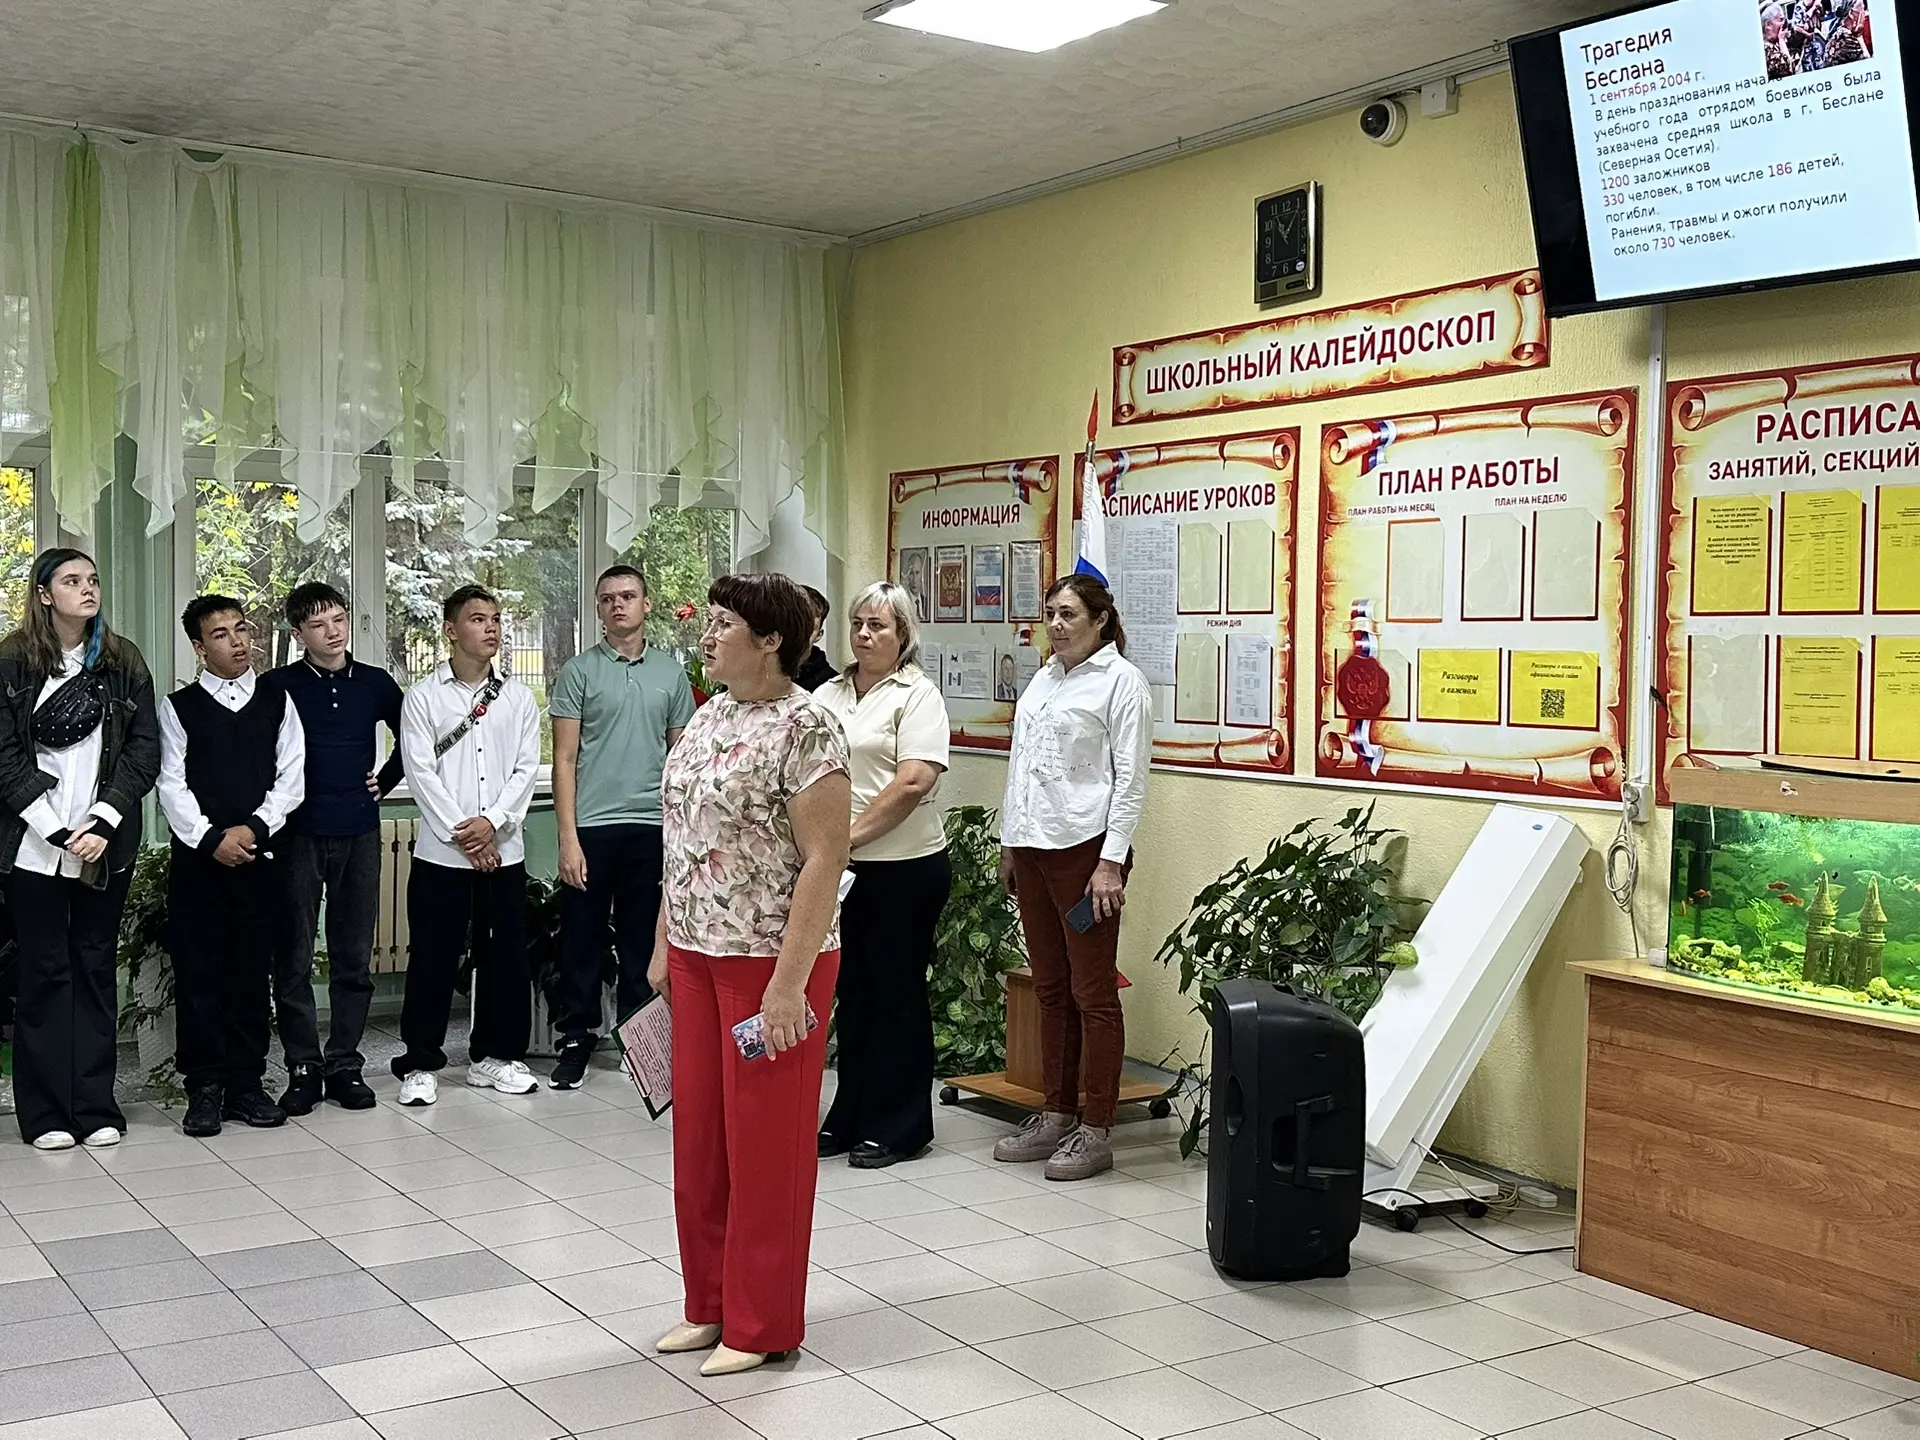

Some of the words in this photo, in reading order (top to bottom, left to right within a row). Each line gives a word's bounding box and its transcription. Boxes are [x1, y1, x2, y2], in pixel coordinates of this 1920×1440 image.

[1580, 28, 1672, 65] Трагедия
[1585, 58, 1665, 90] Беслана
[1589, 93, 1597, 105] 1
[1600, 82, 1657, 103] сентября
[1659, 71, 1691, 89] 2004
[1694, 71, 1706, 82] г.
[1594, 119, 1650, 143] учебного
[1659, 111, 1688, 126] года
[1698, 97, 1756, 117] отрядом
[1766, 80, 1832, 103] боевиков
[1843, 70, 1881, 87] была
[1595, 109, 1603, 122] В
[1607, 105, 1636, 121] день
[1640, 83, 1731, 112] празднования
[1596, 135, 1658, 156] захвачена
[1667, 122, 1720, 143] средняя
[1730, 112, 1773, 130] школа
[1783, 108, 1792, 119] в
[1801, 104, 1812, 116] г.
[1822, 89, 1884, 111] Беслане
[1598, 152, 1661, 175] (Северная
[1664, 139, 1720, 160] Осетия).
[1601, 174, 1630, 191] 1200
[1633, 161, 1711, 185] заложников
[1603, 192, 1625, 207] 330
[1628, 184, 1682, 202] человек,
[1686, 182, 1694, 193] в
[1696, 177, 1721, 191] том
[1724, 169, 1764, 185] числе
[1768, 161, 1792, 178] 186
[1797, 153, 1844, 175] детей,
[1282, 199, 1292, 213] 12
[1605, 206, 1660, 224] погибли.
[1611, 222, 1666, 239] Ранения,
[1669, 213, 1718, 231] травмы
[1721, 211, 1730, 222] и
[1733, 203, 1776, 219] ожоги
[1779, 192, 1848, 212] получили
[1613, 242, 1650, 257] около
[1652, 235, 1675, 251] 730
[1678, 229, 1735, 247] человек.
[1146, 343, 1282, 395] ШКОЛЬНЫЙ
[1289, 309, 1496, 373] КАЛЕЙДОСКОП
[1756, 400, 1920, 444] РАСПИСА
[1379, 467, 1443, 496] ПЛАН
[1451, 456, 1559, 491] РАБОТЫ
[1709, 450, 1816, 481] ЗАНЯТИЙ,
[1823, 441, 1919, 473] СЕКЦИЙ
[922, 503, 1020, 529] ИНФОРМАЦИЯ
[1101, 489, 1199, 518] АСПИСАНИЕ
[1204, 483, 1276, 511] УРОКОВ
[1348, 507, 1367, 516] ПЛАН
[1368, 505, 1397, 515] РАБОТЫ
[1398, 504, 1408, 513] НА
[1410, 503, 1435, 513] МЕСЯЦ
[1494, 497, 1517, 507] ПЛАН
[1518, 496, 1529, 505] НА
[1531, 493, 1568, 505] НЕДЕЛЮ
[1206, 619, 1228, 627] РЕЖИМ
